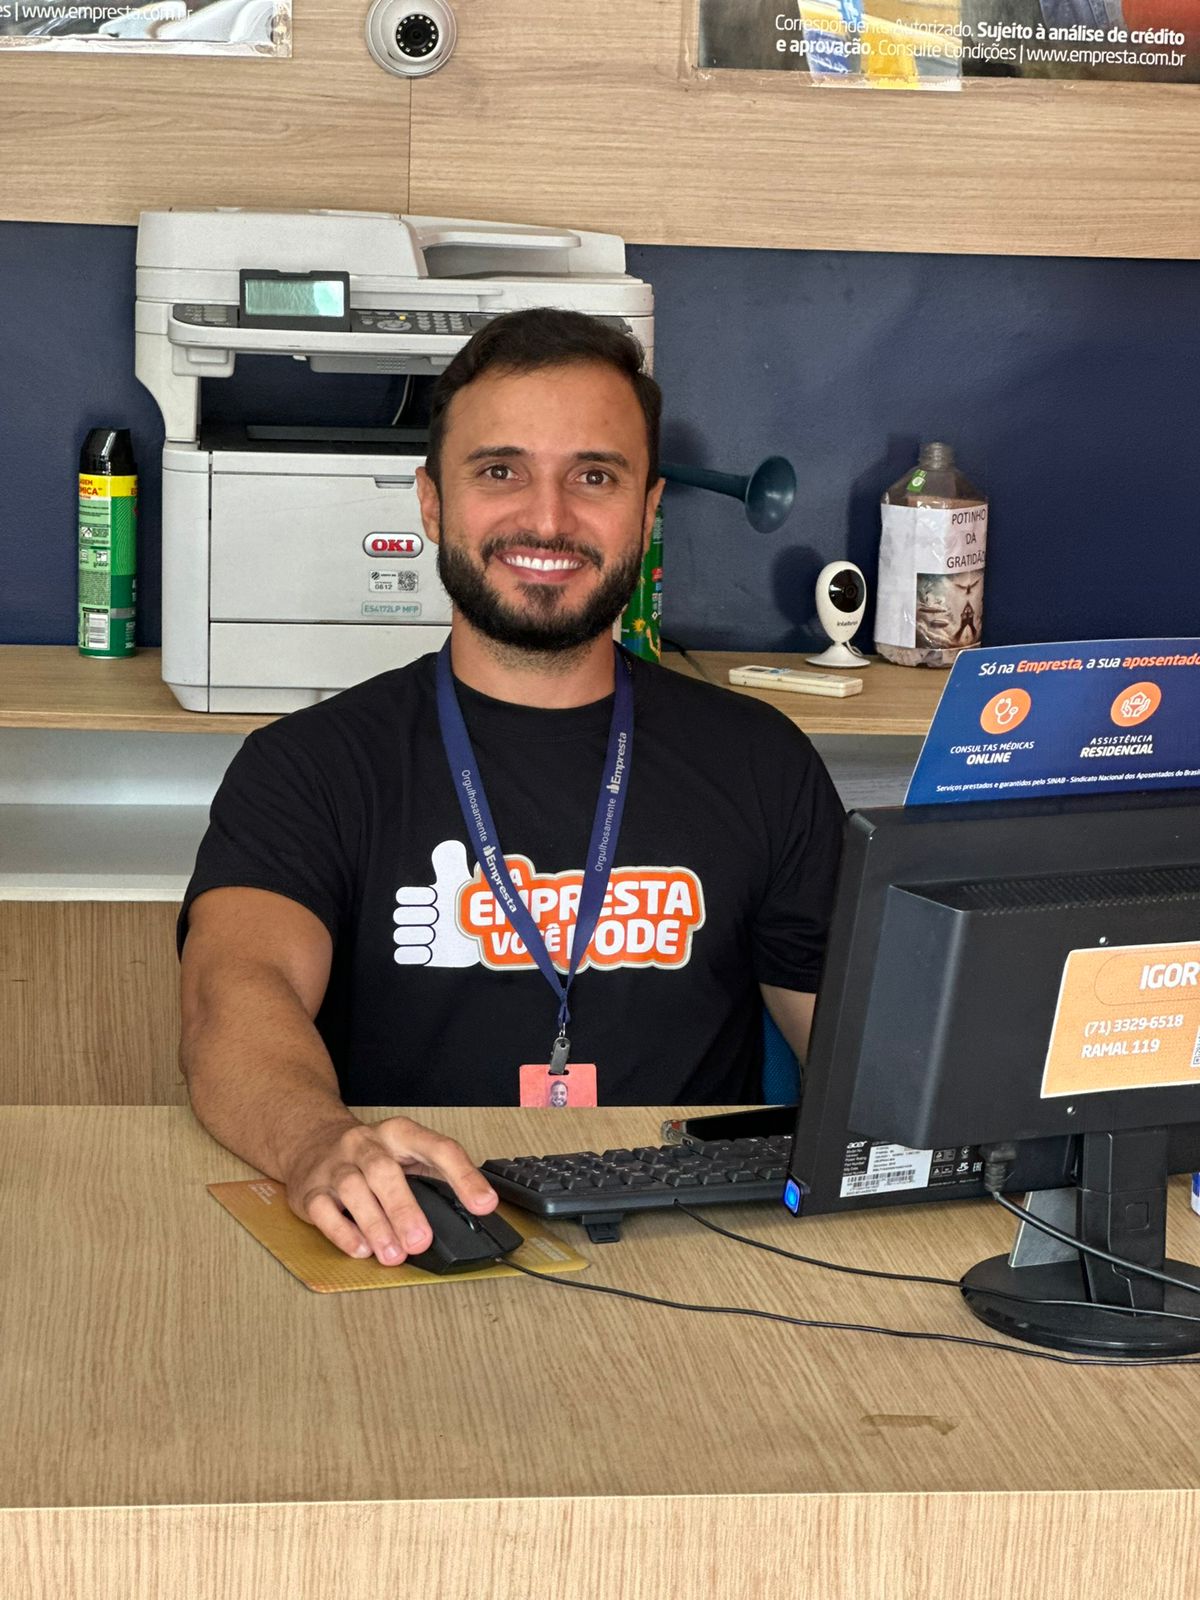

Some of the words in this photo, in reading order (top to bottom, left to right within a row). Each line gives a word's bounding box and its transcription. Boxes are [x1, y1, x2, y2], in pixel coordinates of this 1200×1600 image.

[775, 14, 889, 36] Correspondente
[892, 18, 974, 37] Autorizado.
[978, 21, 1033, 42] Sujeito
[1035, 24, 1046, 40] à
[1048, 24, 1105, 42] análise
[1107, 26, 1128, 43] de
[1130, 28, 1185, 45] crédito
[776, 39, 787, 52] e
[790, 38, 875, 58] aprovação.
[879, 39, 941, 58] Consulte
[945, 43, 1017, 64] Condições
[1026, 48, 1187, 67] www.empresta.com.br
[952, 509, 986, 525] POTINHO
[371, 539, 415, 552] OKI
[966, 532, 977, 545] DA
[978, 661, 997, 677] Só
[997, 663, 1015, 675] na
[1016, 658, 1084, 674] Empresta,
[1086, 658, 1095, 669] a
[1097, 656, 1120, 668] sua
[950, 743, 998, 754] CONSULTAS
[999, 740, 1036, 751] MÉDICAS
[1090, 733, 1153, 745] ASSISTÊNCIA
[610, 731, 628, 785] Empresta
[966, 751, 1012, 766] ONLINE
[1079, 743, 1154, 758] RESIDENCIAL
[936, 784, 962, 793] Serviços
[962, 782, 993, 791] prestados
[999, 779, 1031, 789] garantidos
[1032, 778, 1046, 787] pelo
[1070, 775, 1098, 783] Sindicato
[1098, 773, 1124, 781] Nacional
[1124, 772, 1136, 780] dos
[1136, 771, 1175, 780] Aposentados
[1175, 769, 1184, 777] do
[461, 769, 488, 842] Orgulhosamente
[594, 797, 617, 872] Orgulhosamente
[485, 854, 518, 913] Empresta
[490, 922, 561, 956] VOÊ
[1138, 961, 1200, 990] IGOR
[1084, 1020, 1112, 1037] (71)
[1113, 1014, 1184, 1033] 3329-6518
[1081, 1042, 1129, 1058] RAMAL
[1132, 1038, 1161, 1055] 119
[846, 1140, 868, 1149] acer
